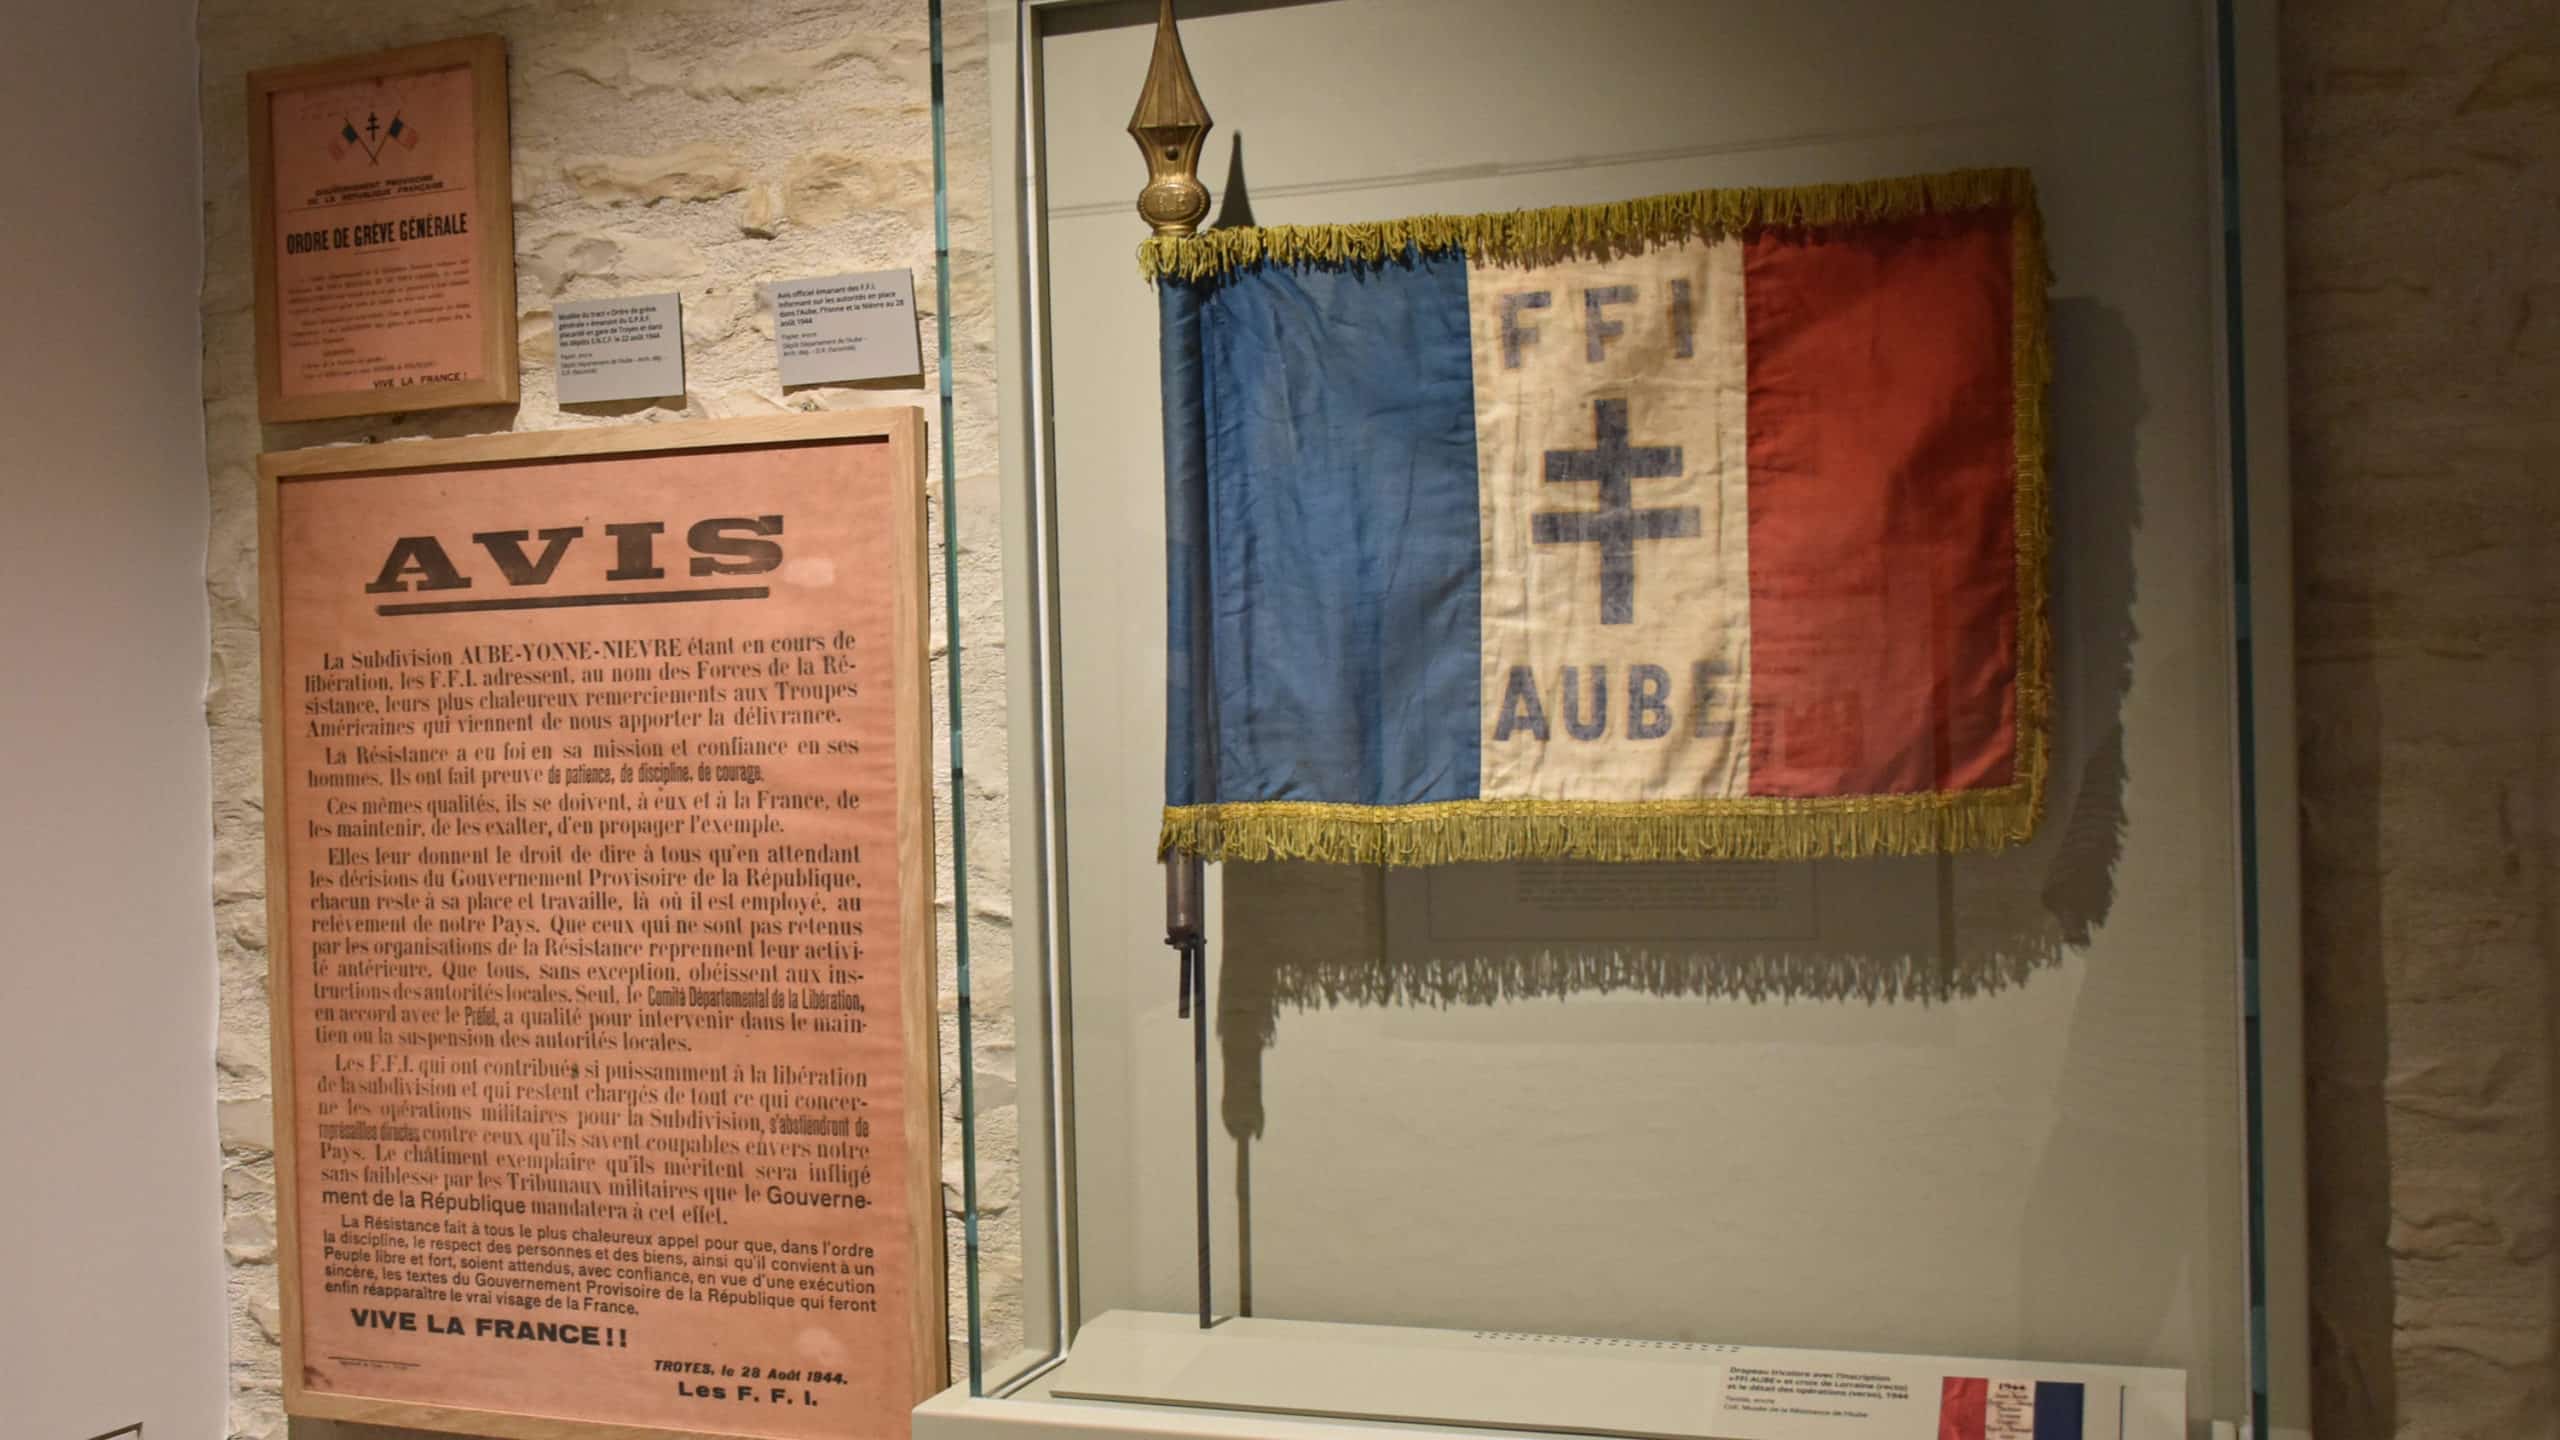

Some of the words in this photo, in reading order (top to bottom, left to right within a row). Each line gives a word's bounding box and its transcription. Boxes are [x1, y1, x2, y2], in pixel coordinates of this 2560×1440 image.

[288, 230, 328, 254] ORDRE
[334, 228, 350, 249] DE
[354, 220, 395, 247] GRÈVE
[400, 212, 468, 240] GÉNÉRALE
[1501, 278, 1694, 368] FFI
[373, 378, 394, 389] VIVE
[401, 377, 413, 386] LA
[421, 373, 461, 384] FRANCE
[365, 514, 783, 593] AVIS
[322, 651, 344, 668] La
[350, 647, 453, 667] Subdivision
[460, 638, 682, 663] AUBE-YONNE-NIEVRE
[686, 636, 734, 655] étant
[741, 639, 765, 653] en
[769, 637, 826, 652] cours
[832, 631, 856, 650] de
[400, 670, 425, 687] les
[581, 668, 603, 682] au
[611, 666, 652, 681] nom
[658, 661, 690, 679] des
[696, 658, 762, 678] Forces
[767, 657, 790, 675] de
[796, 656, 814, 674] la
[822, 655, 856, 674] Ré-
[1494, 662, 1735, 742] AUBE
[309, 869, 334, 885] les
[338, 869, 418, 885] décisions
[422, 869, 444, 886] du
[450, 869, 582, 886] Gouvernement
[588, 869, 687, 886] Provisoire
[693, 868, 715, 886] de
[721, 868, 739, 886] la
[321, 1185, 368, 1204] ment
[371, 1188, 395, 1205] de
[398, 1189, 415, 1207] la
[419, 1190, 527, 1216] République
[530, 1196, 628, 1218] mandatera
[631, 1202, 643, 1219] à
[648, 1202, 675, 1221] cet
[323, 1246, 371, 1264] Peuple
[374, 1249, 406, 1263] libre
[409, 1252, 424, 1265] et
[459, 1255, 504, 1270] soient
[577, 1265, 612, 1277] avec
[696, 1272, 716, 1283] en
[719, 1274, 748, 1285] vue
[751, 1273, 795, 1289] d'une
[797, 1276, 876, 1294] exécution
[351, 1308, 417, 1331] VIVE
[428, 1315, 465, 1336] LA
[679, 1380, 726, 1400] Les
[719, 1362, 735, 1379] le
[740, 1363, 761, 1381] 28
[765, 1365, 801, 1384] Août
